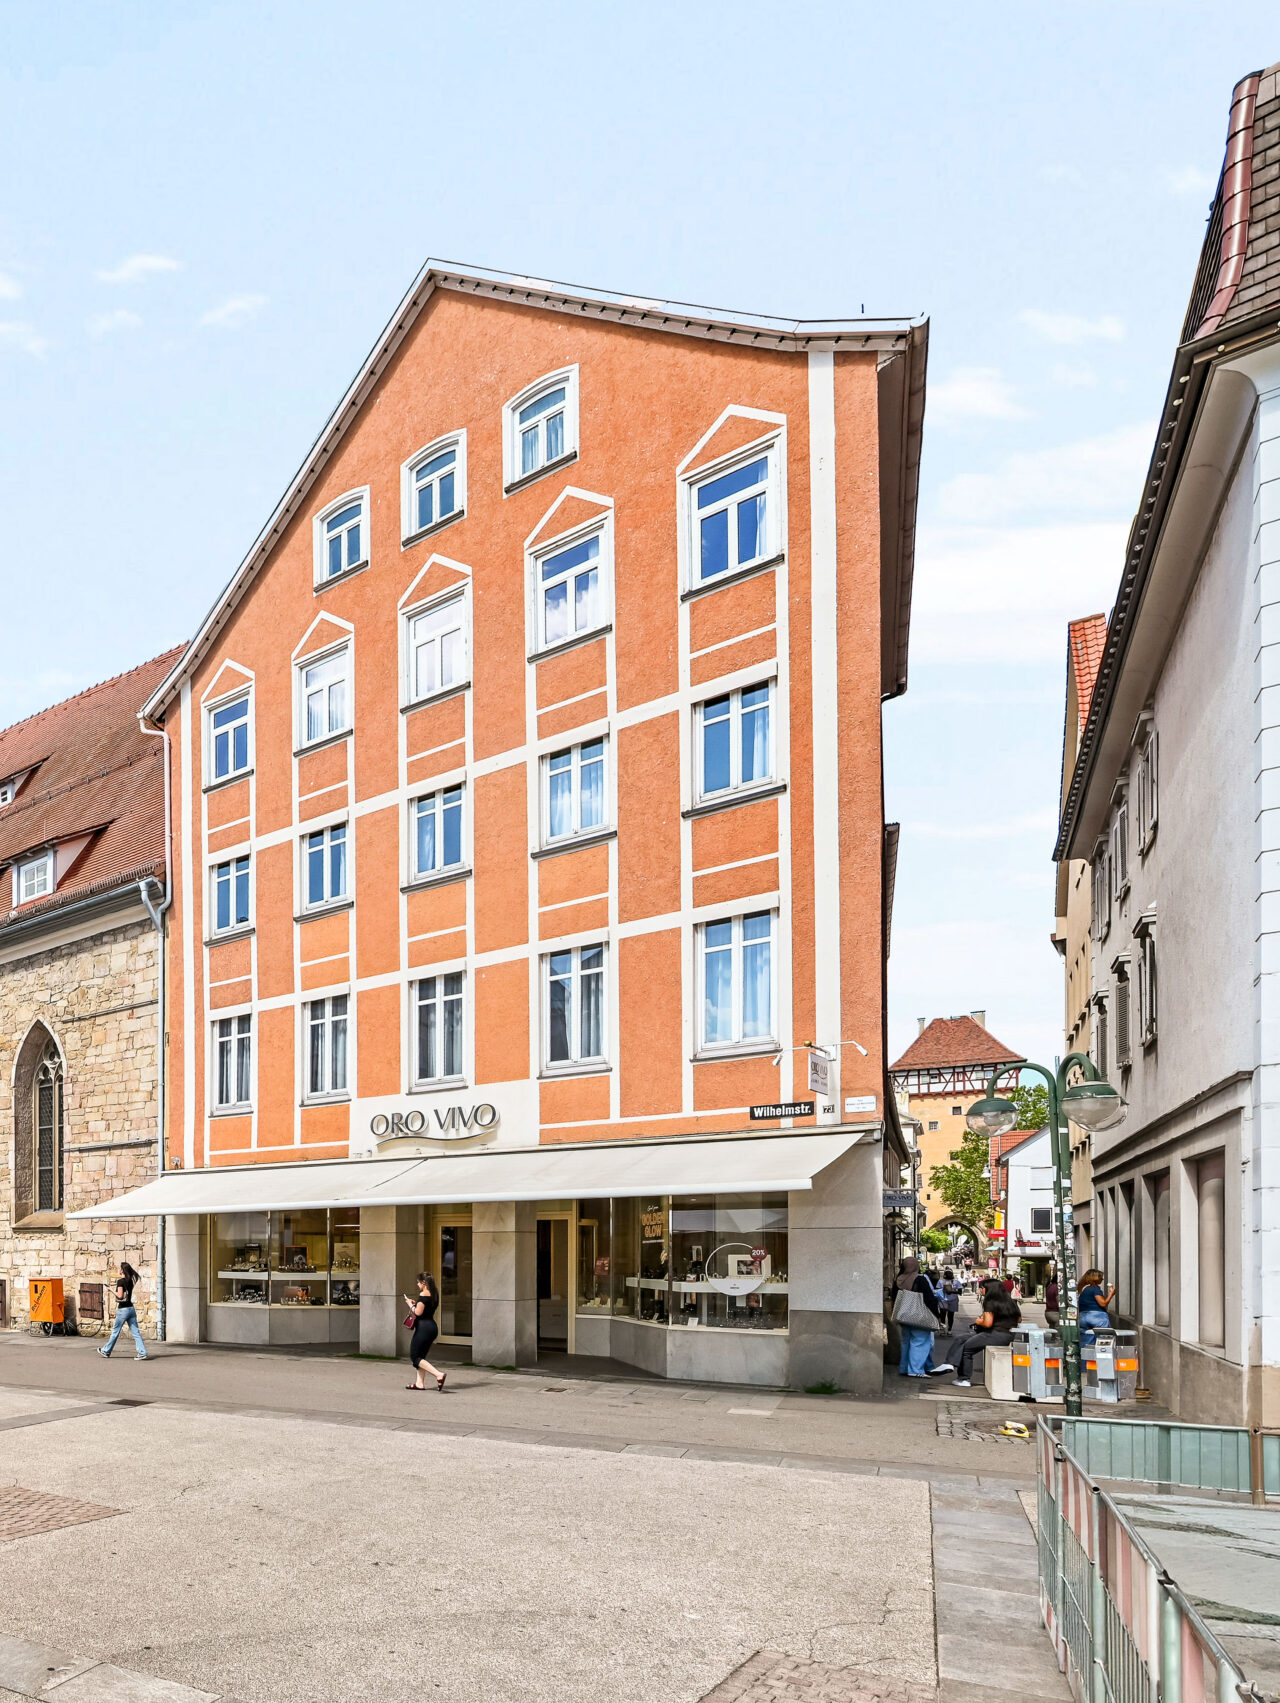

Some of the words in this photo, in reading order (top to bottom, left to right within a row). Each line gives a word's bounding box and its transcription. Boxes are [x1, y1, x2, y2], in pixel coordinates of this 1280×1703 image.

[753, 1103, 812, 1118] Wilhelmstr.
[370, 1110, 427, 1136] ORO
[433, 1103, 497, 1130] VIVO
[641, 1211, 665, 1226] GOLDEN
[644, 1224, 662, 1238] GLOW
